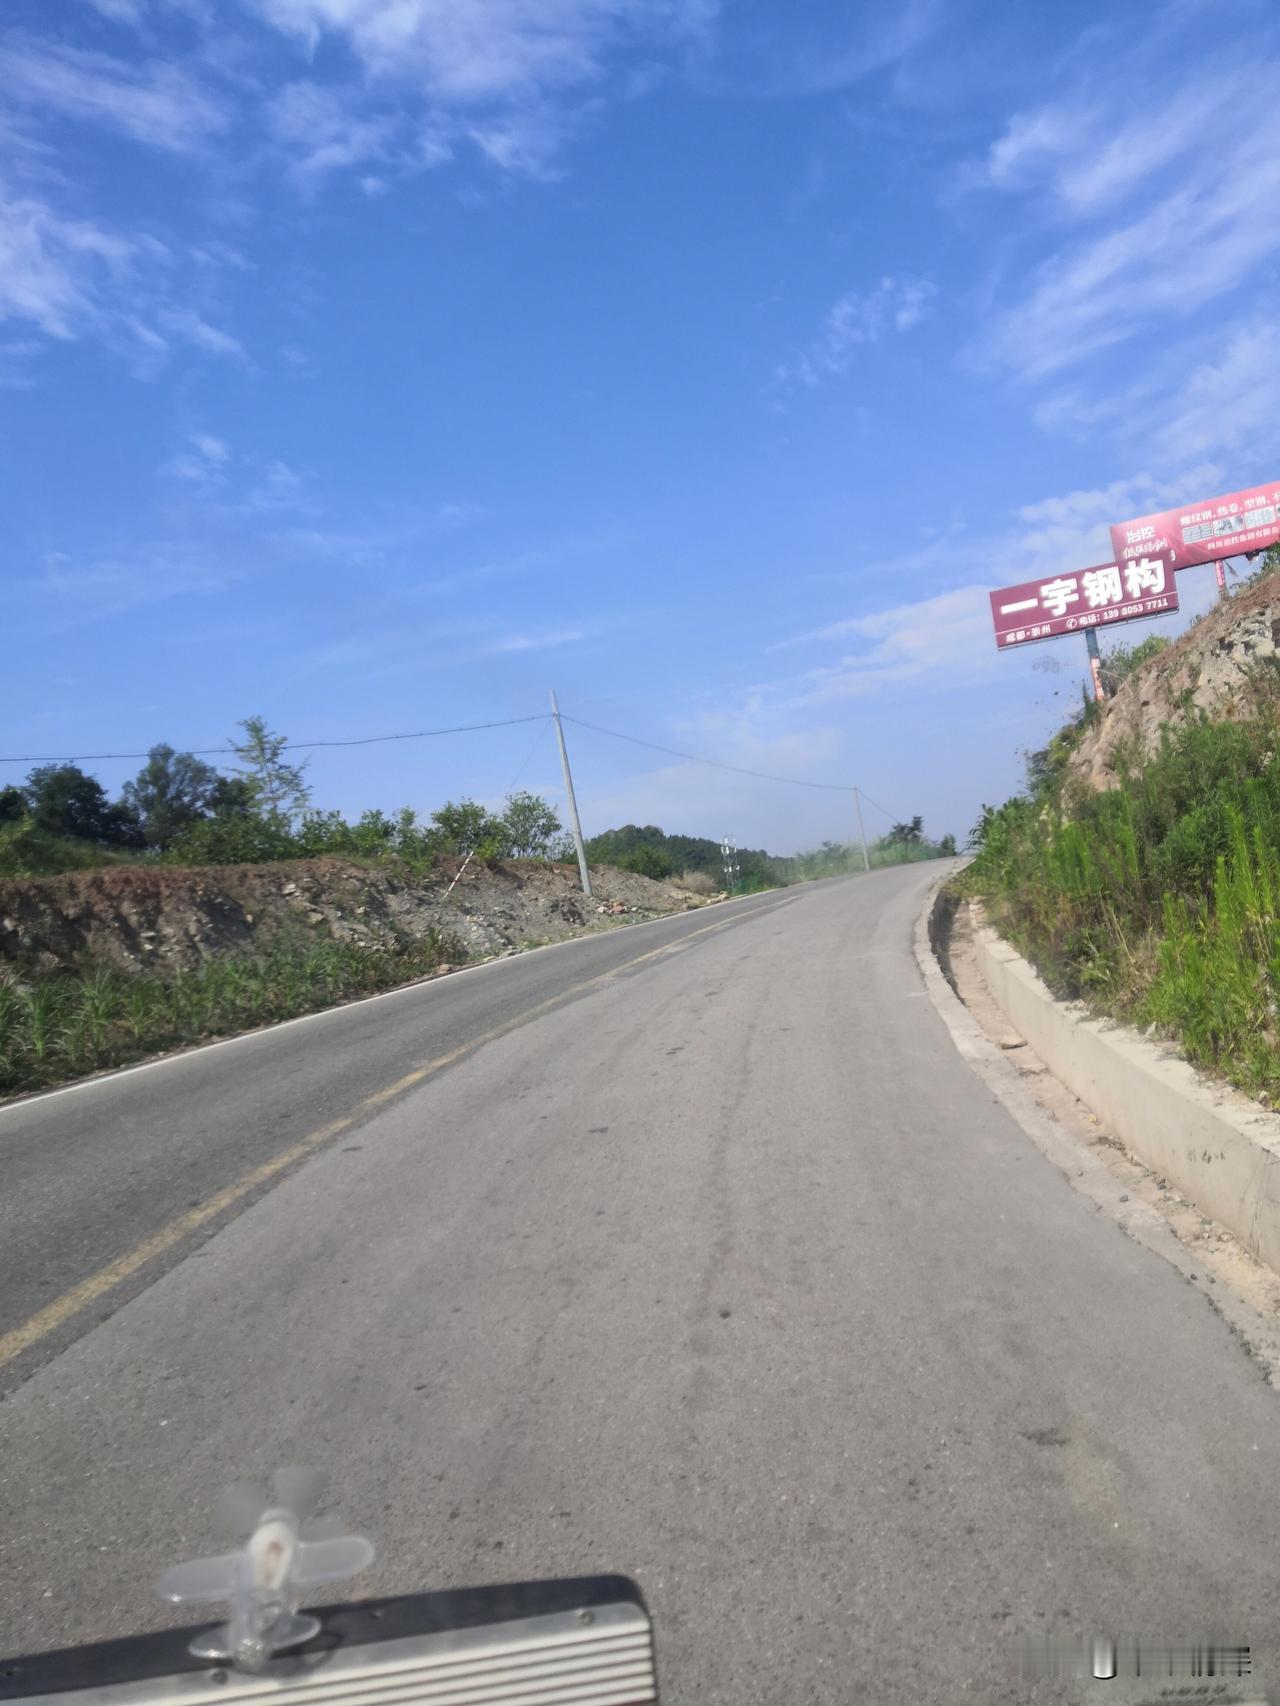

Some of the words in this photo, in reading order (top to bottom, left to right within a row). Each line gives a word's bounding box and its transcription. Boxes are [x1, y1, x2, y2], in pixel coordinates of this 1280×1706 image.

[999, 558, 1166, 616] 一宇钢构
[1103, 610, 1119, 620] 139
[1121, 605, 1144, 616] 8053
[1146, 598, 1168, 610] 7711
